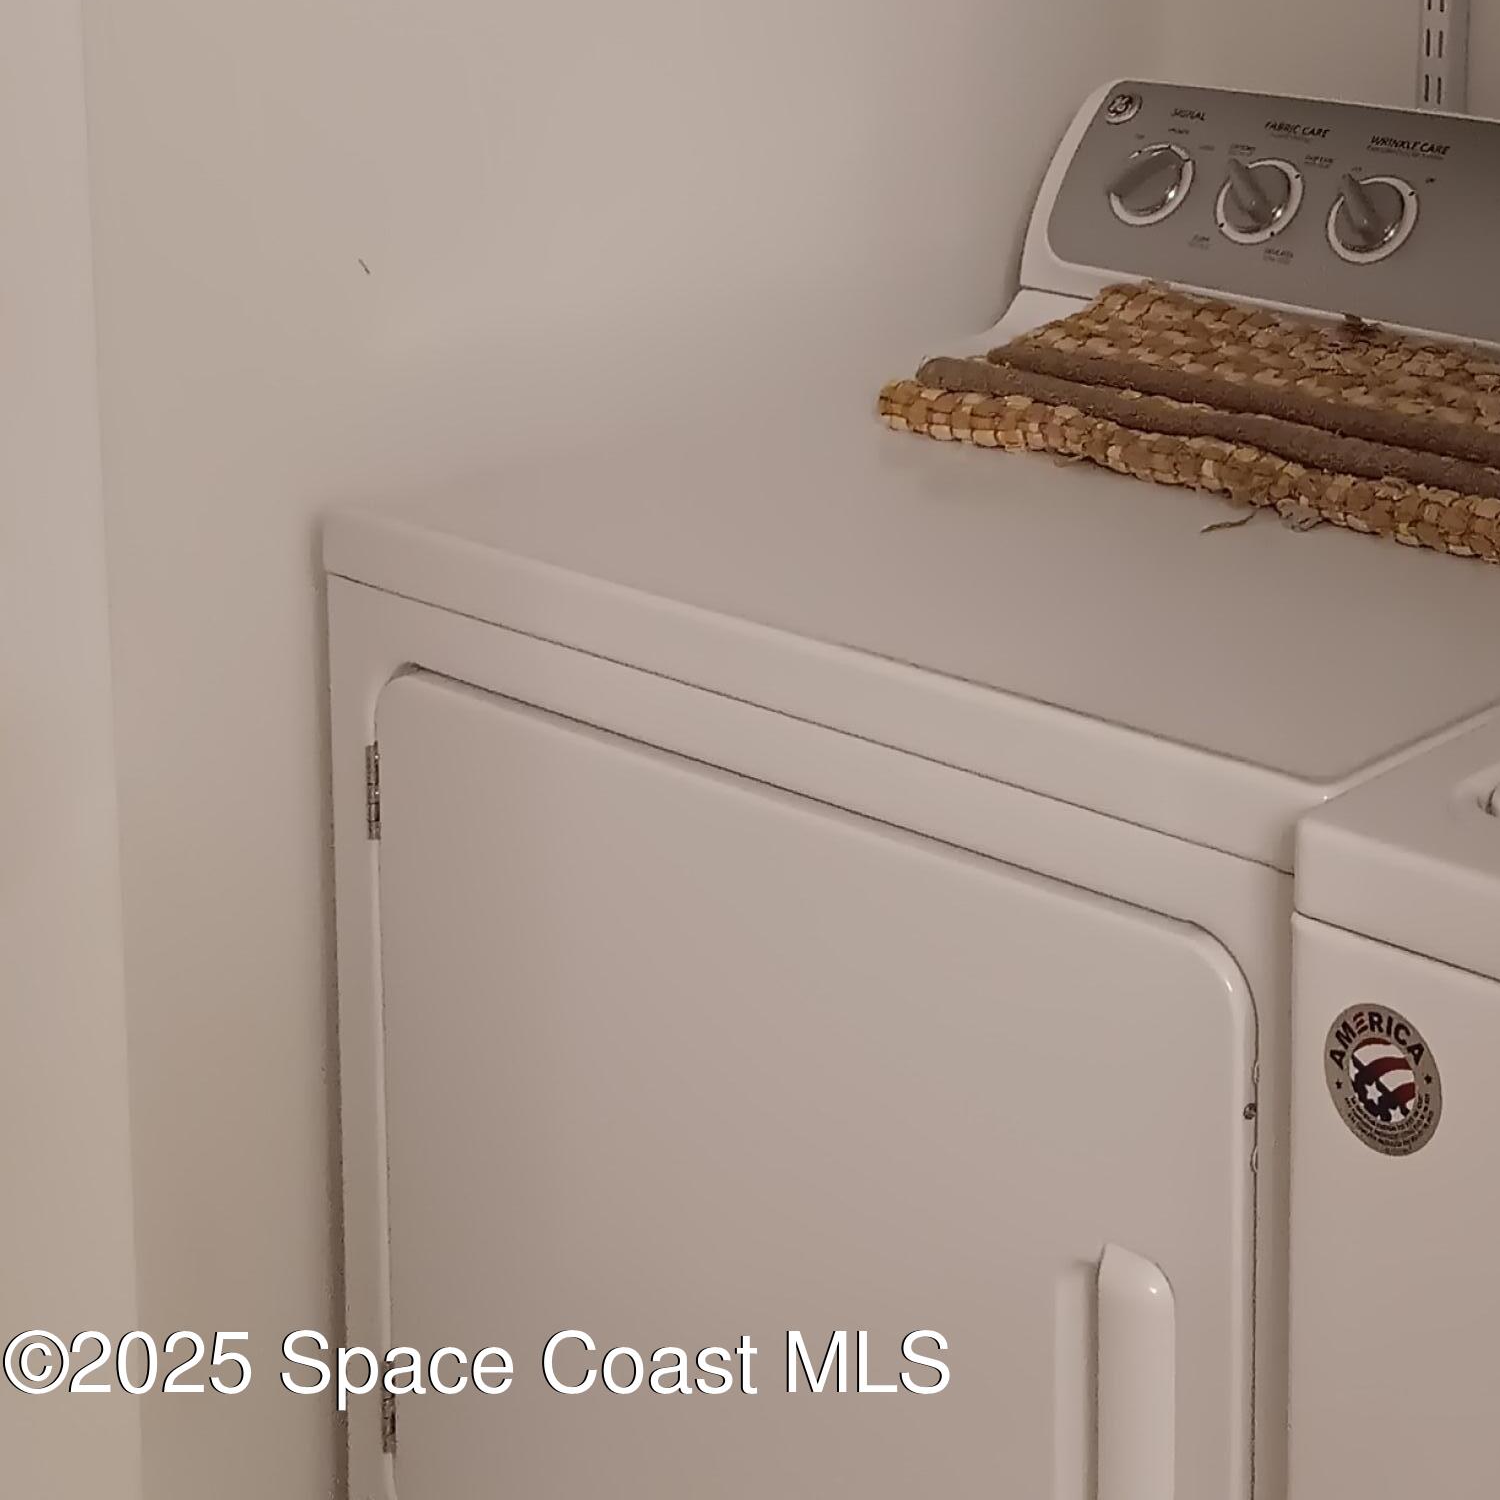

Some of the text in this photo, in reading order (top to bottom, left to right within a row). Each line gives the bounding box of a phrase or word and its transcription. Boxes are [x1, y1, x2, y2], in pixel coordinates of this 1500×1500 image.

[1264, 120, 1301, 135] FABRIC
[1301, 125, 1330, 139] CARE
[1371, 135, 1421, 151] WRINKLE
[1420, 142, 1450, 155] CARE
[1329, 1011, 1425, 1071] AMERICA
